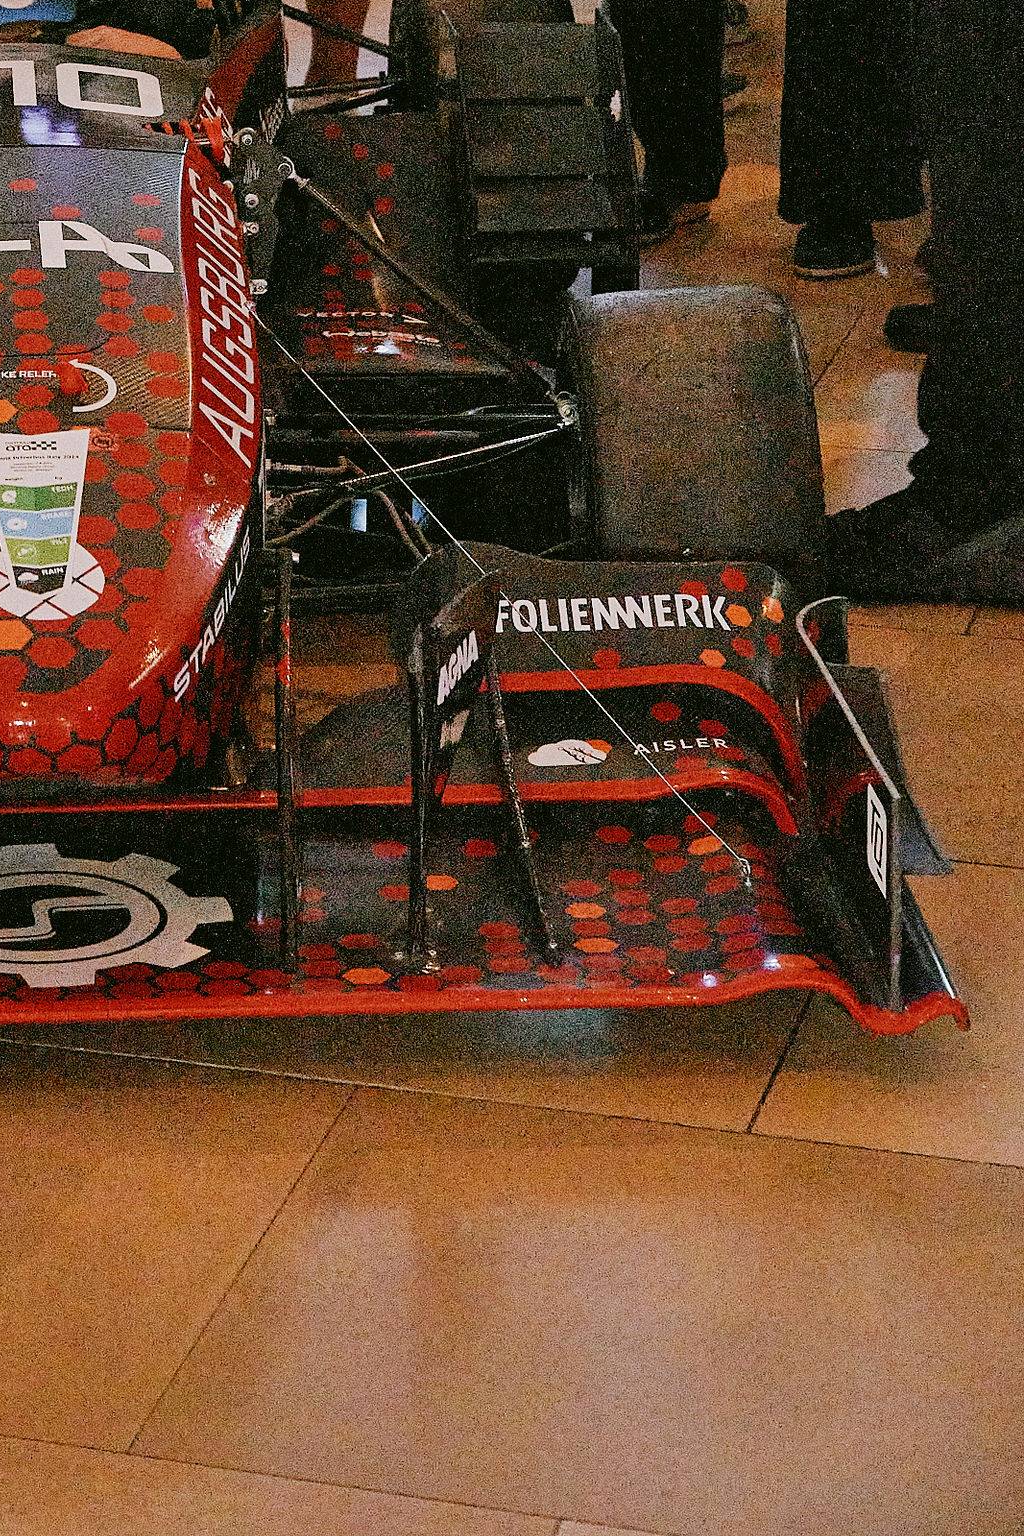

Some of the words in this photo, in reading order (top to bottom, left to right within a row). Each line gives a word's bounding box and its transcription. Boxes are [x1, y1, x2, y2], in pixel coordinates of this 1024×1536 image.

[188, 166, 257, 470] AUGSBURG
[41, 567, 65, 576] RAIN
[495, 593, 732, 633] FOLIENWERK
[436, 629, 479, 706] AGNA
[633, 736, 729, 756] AISLER
